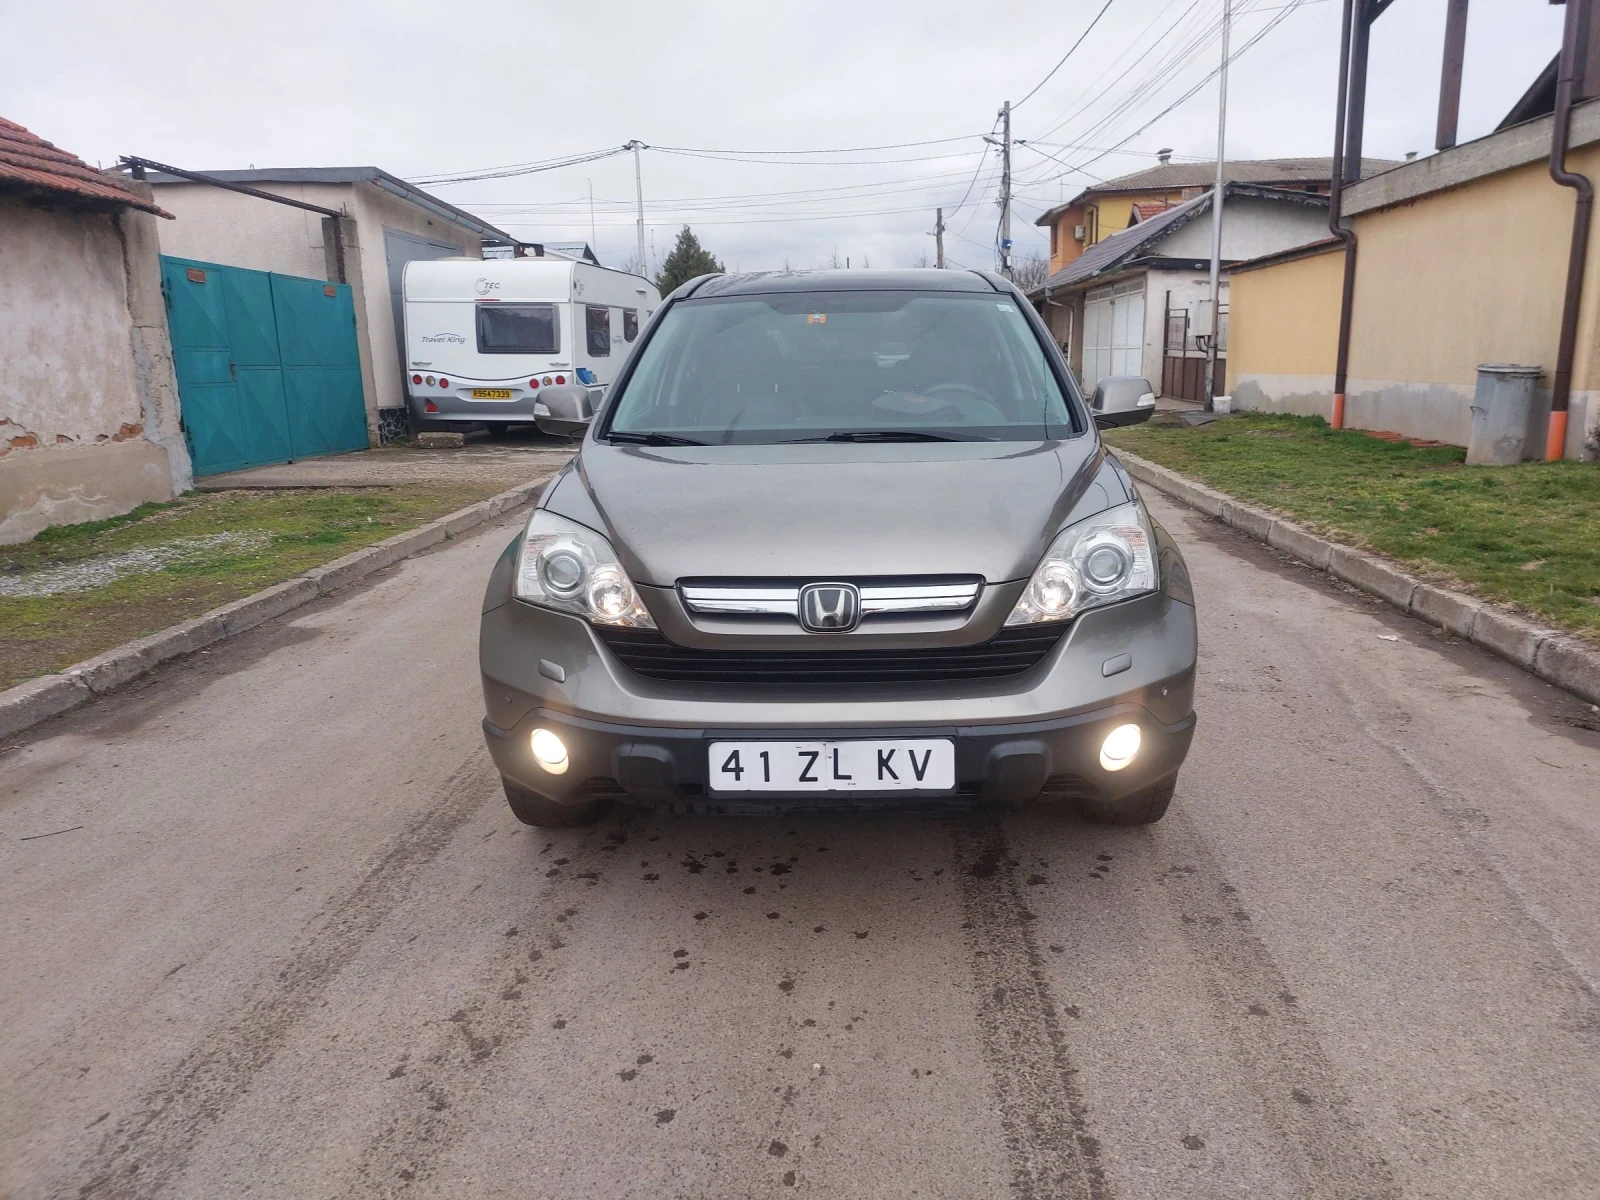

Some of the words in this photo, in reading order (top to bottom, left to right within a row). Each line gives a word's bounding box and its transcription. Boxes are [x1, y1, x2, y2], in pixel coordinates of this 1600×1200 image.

[446, 336, 466, 344] King
[473, 389, 510, 398] R9547339
[721, 749, 771, 782] 41
[877, 748, 932, 782] KV
